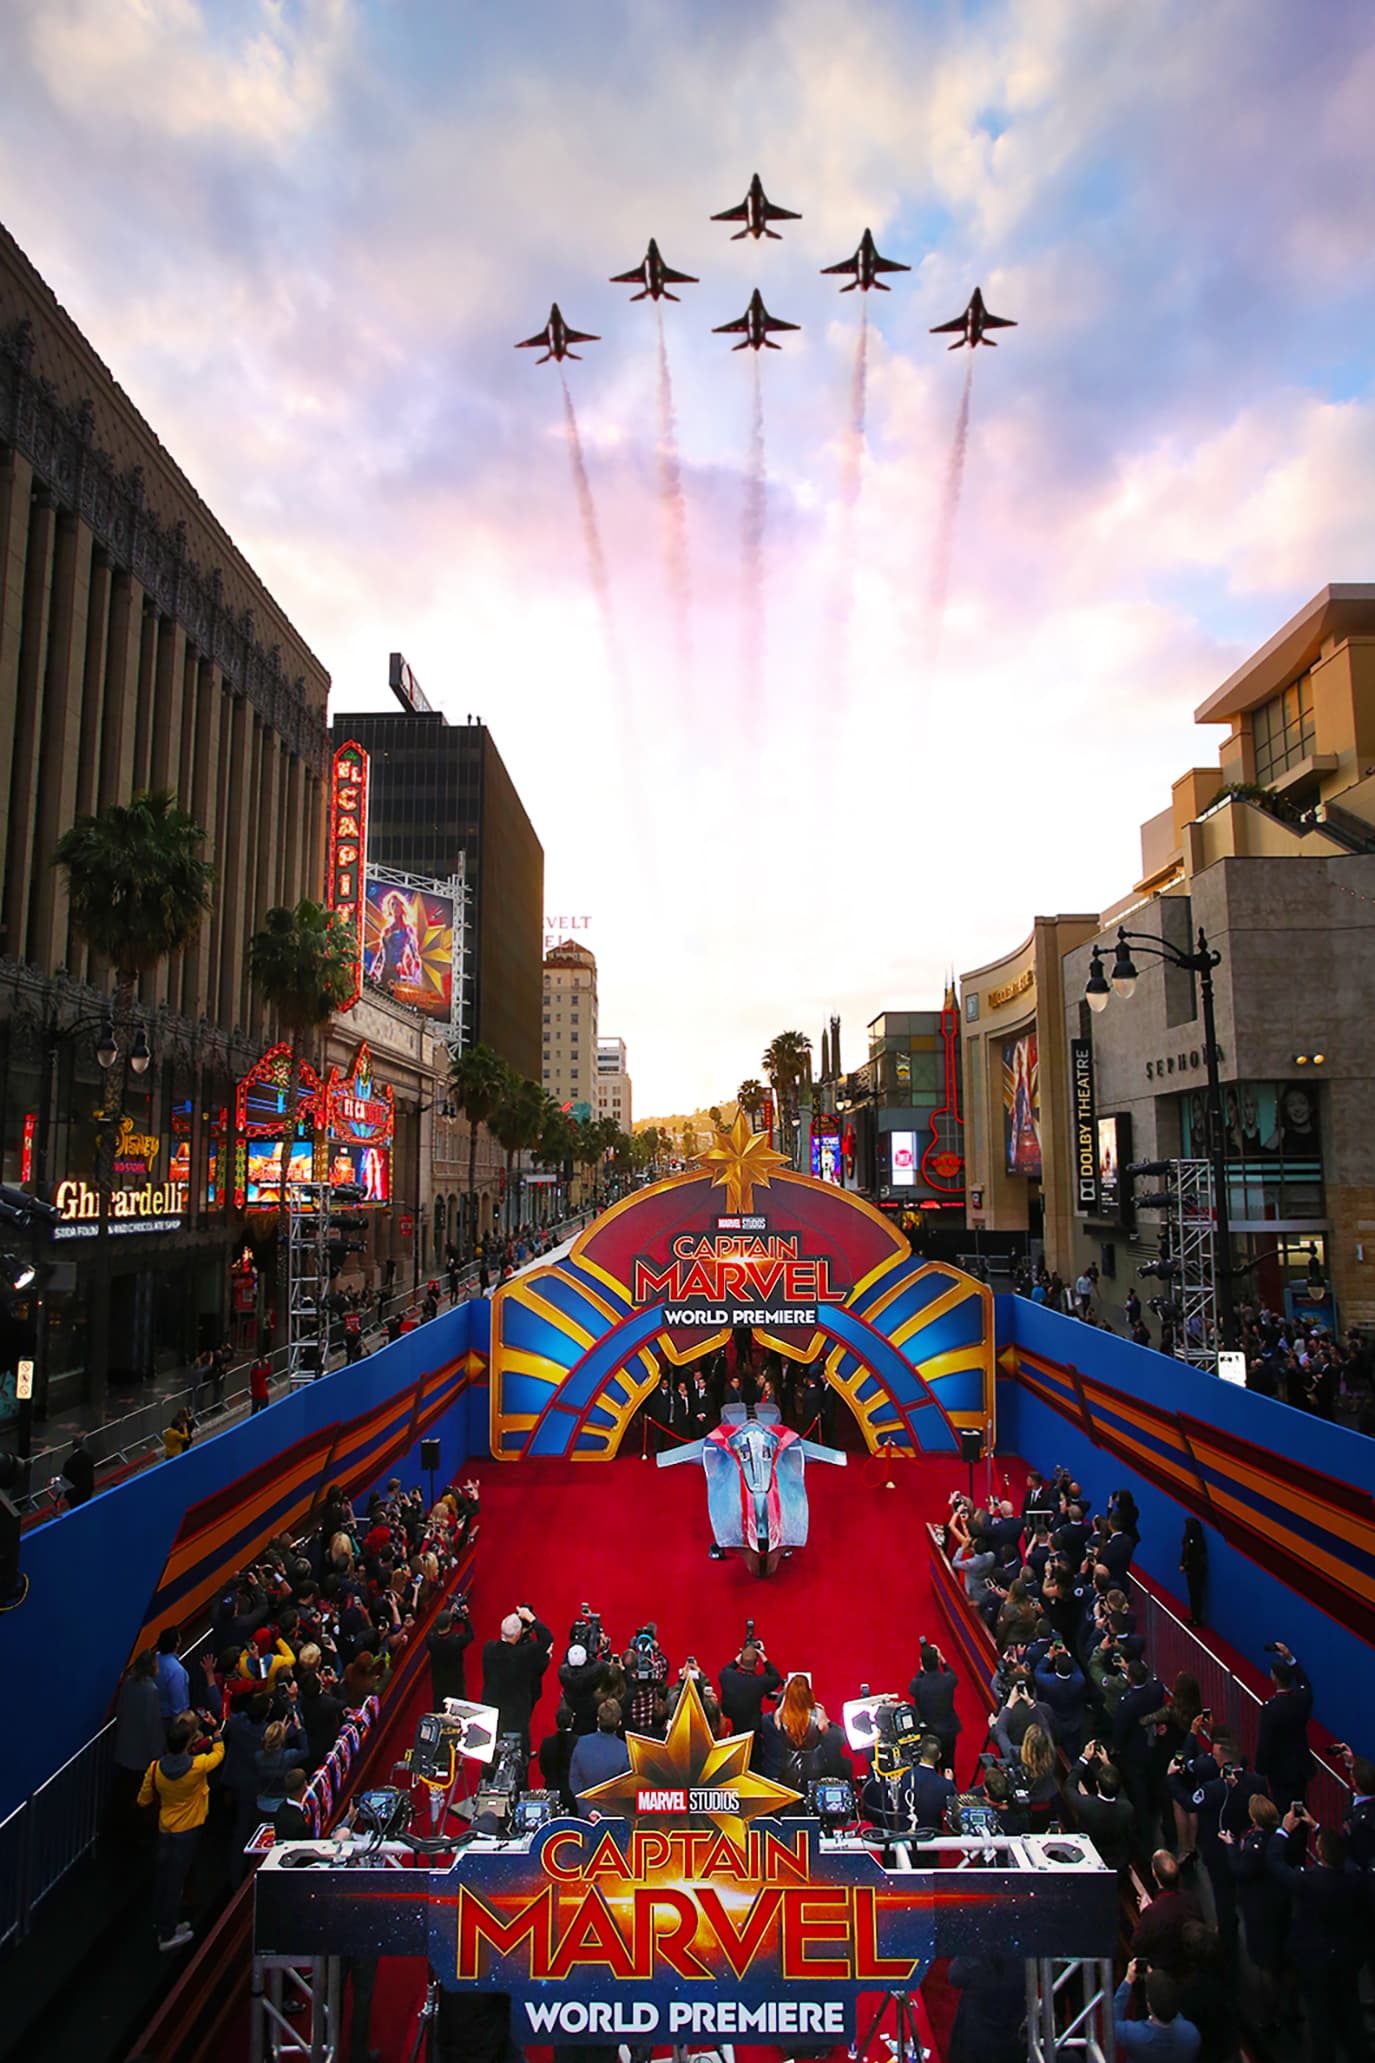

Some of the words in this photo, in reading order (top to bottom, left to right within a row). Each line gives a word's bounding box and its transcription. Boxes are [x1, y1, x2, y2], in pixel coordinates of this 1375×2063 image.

[335, 786, 360, 935] CAPIT
[1076, 1048, 1091, 1123] THEATRE
[1079, 1124, 1095, 1177] DOLBY
[673, 1235, 798, 1260] CAPTAIN
[634, 1258, 848, 1303] MARVEL
[664, 1309, 729, 1325] WORLD
[733, 1309, 816, 1325] PREMIERE
[638, 1791, 688, 1811] MARVEL
[689, 1791, 740, 1811] STUDIOS
[540, 1829, 810, 1883] CAPTAIN
[456, 1882, 920, 1982] MARVEL
[524, 2001, 660, 2033] WORLD
[669, 2001, 845, 2033] PREMIERE
